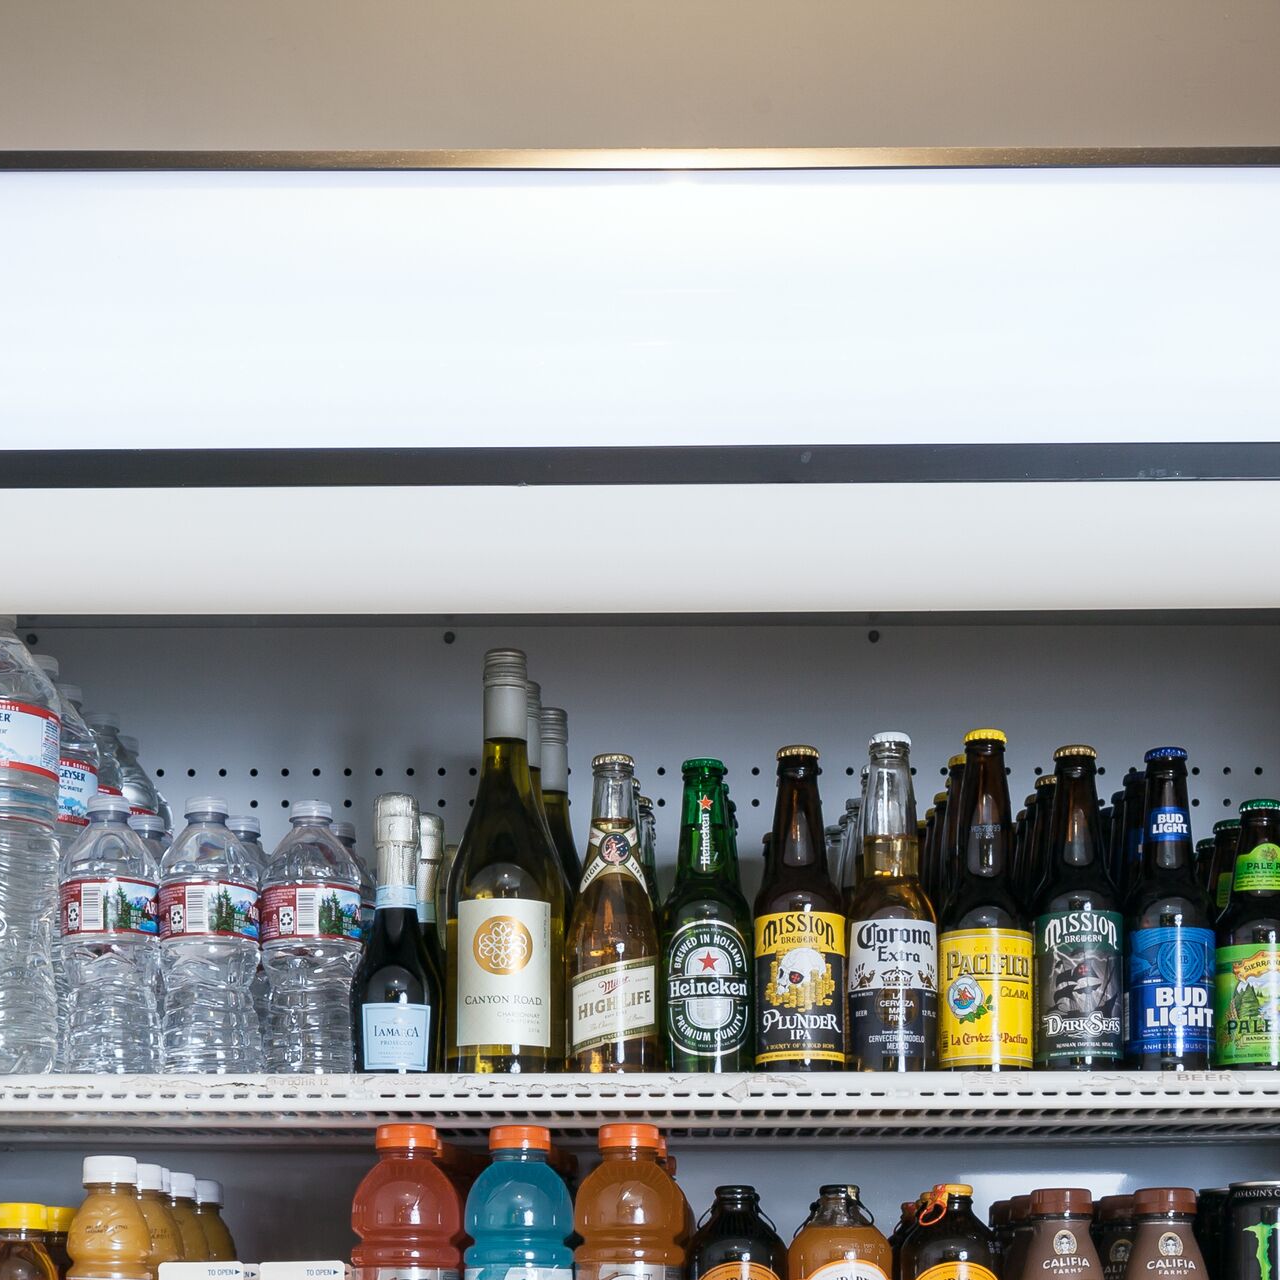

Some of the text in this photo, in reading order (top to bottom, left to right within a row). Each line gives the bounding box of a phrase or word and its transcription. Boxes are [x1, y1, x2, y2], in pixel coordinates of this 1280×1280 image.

[1157, 814, 1183, 824] BUD
[1152, 823, 1188, 834] LIGHT
[763, 914, 837, 950] MISSION
[856, 923, 934, 951] Corona
[1045, 912, 1117, 952] MISSION
[674, 935, 743, 969] BREWED IN HOLLAND
[877, 947, 920, 964] Extra
[669, 980, 747, 997] Heineken
[1156, 987, 1207, 1007] BUD
[763, 1009, 841, 1033] PLUNDER
[1146, 1007, 1213, 1027] LIGHT
[675, 1014, 711, 1042] PREMIUM
[714, 1014, 744, 1042] QUALITY
[790, 1030, 811, 1040] IPA
[1227, 1020, 1271, 1035] PALE
[1177, 1073, 1231, 1083] BEER
[1043, 1257, 1090, 1270] CALIFIA
